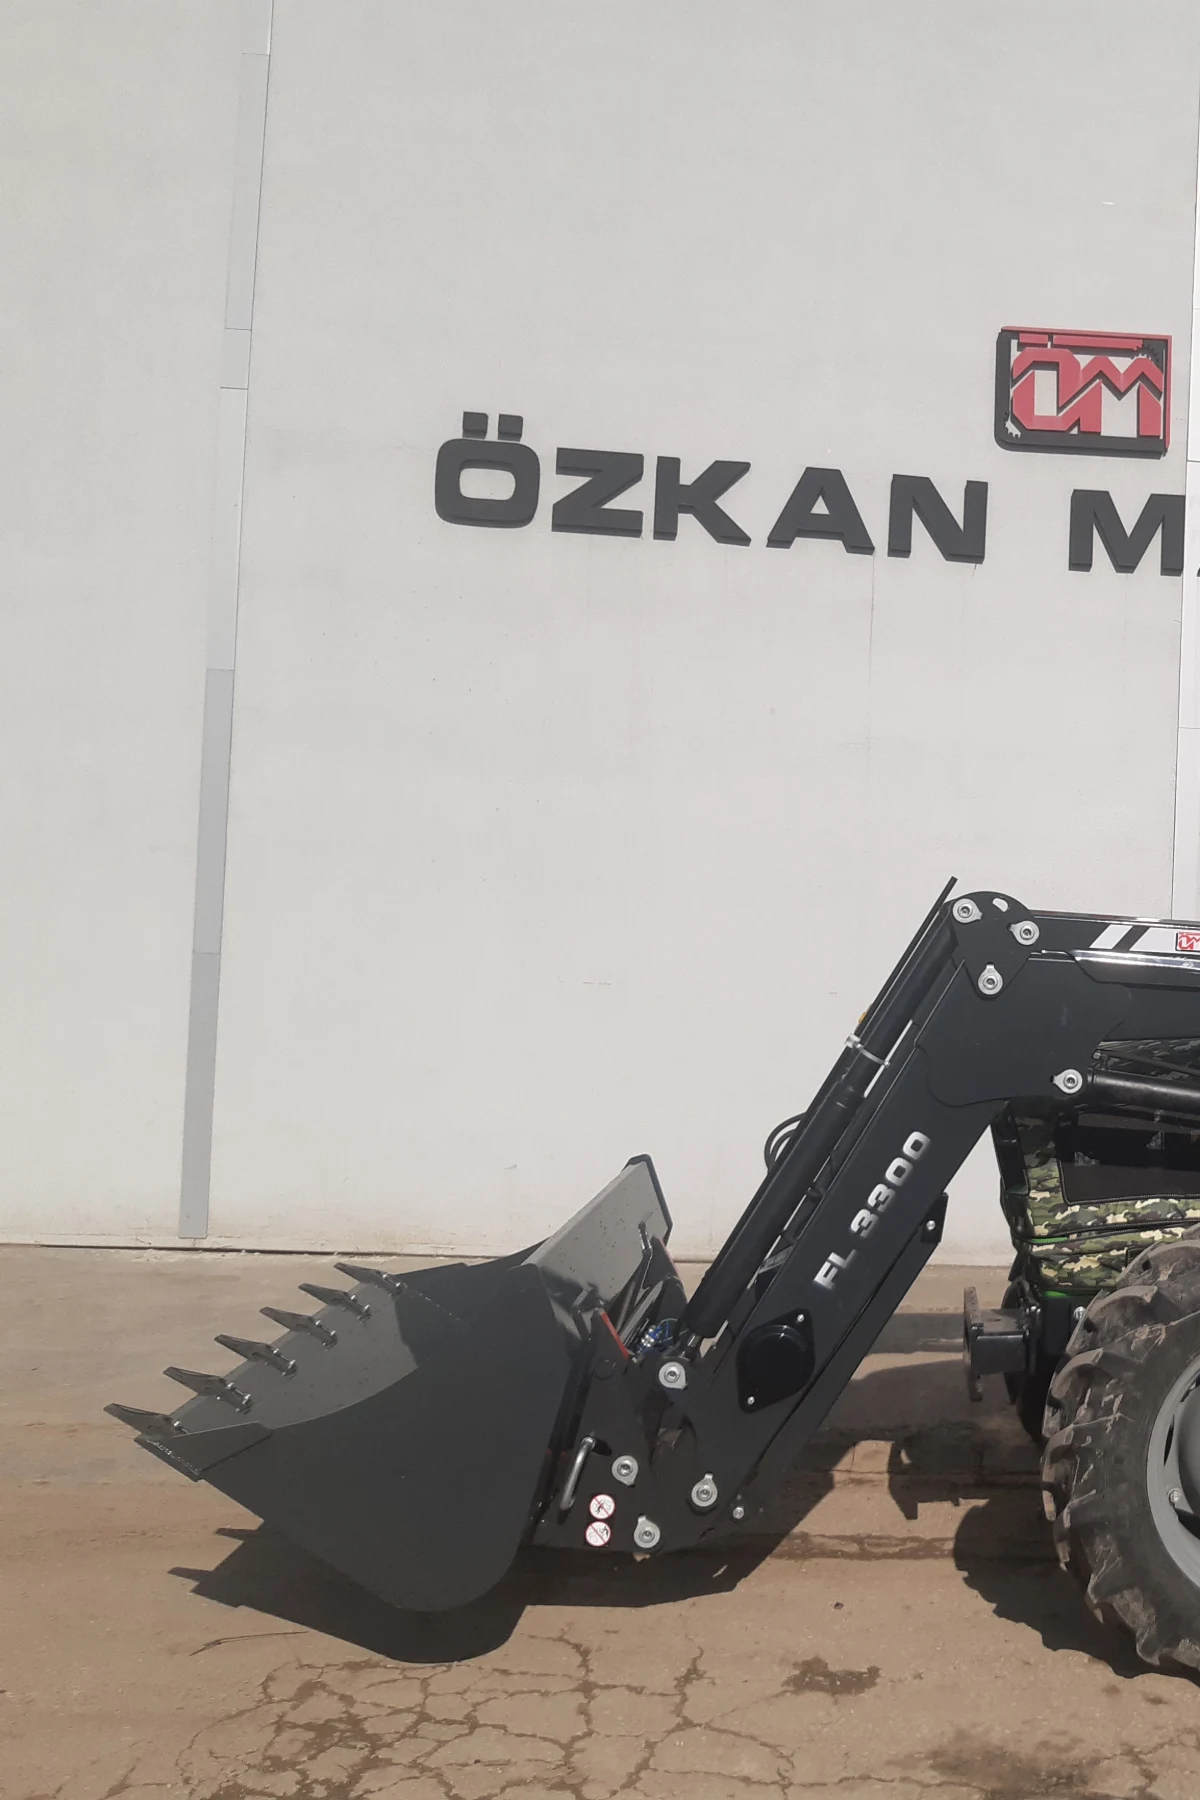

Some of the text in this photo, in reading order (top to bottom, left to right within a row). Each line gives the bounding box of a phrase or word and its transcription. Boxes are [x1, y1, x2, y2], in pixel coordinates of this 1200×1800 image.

[435, 411, 989, 564] ÖZKAN
[813, 1131, 931, 1290] FL 3300
